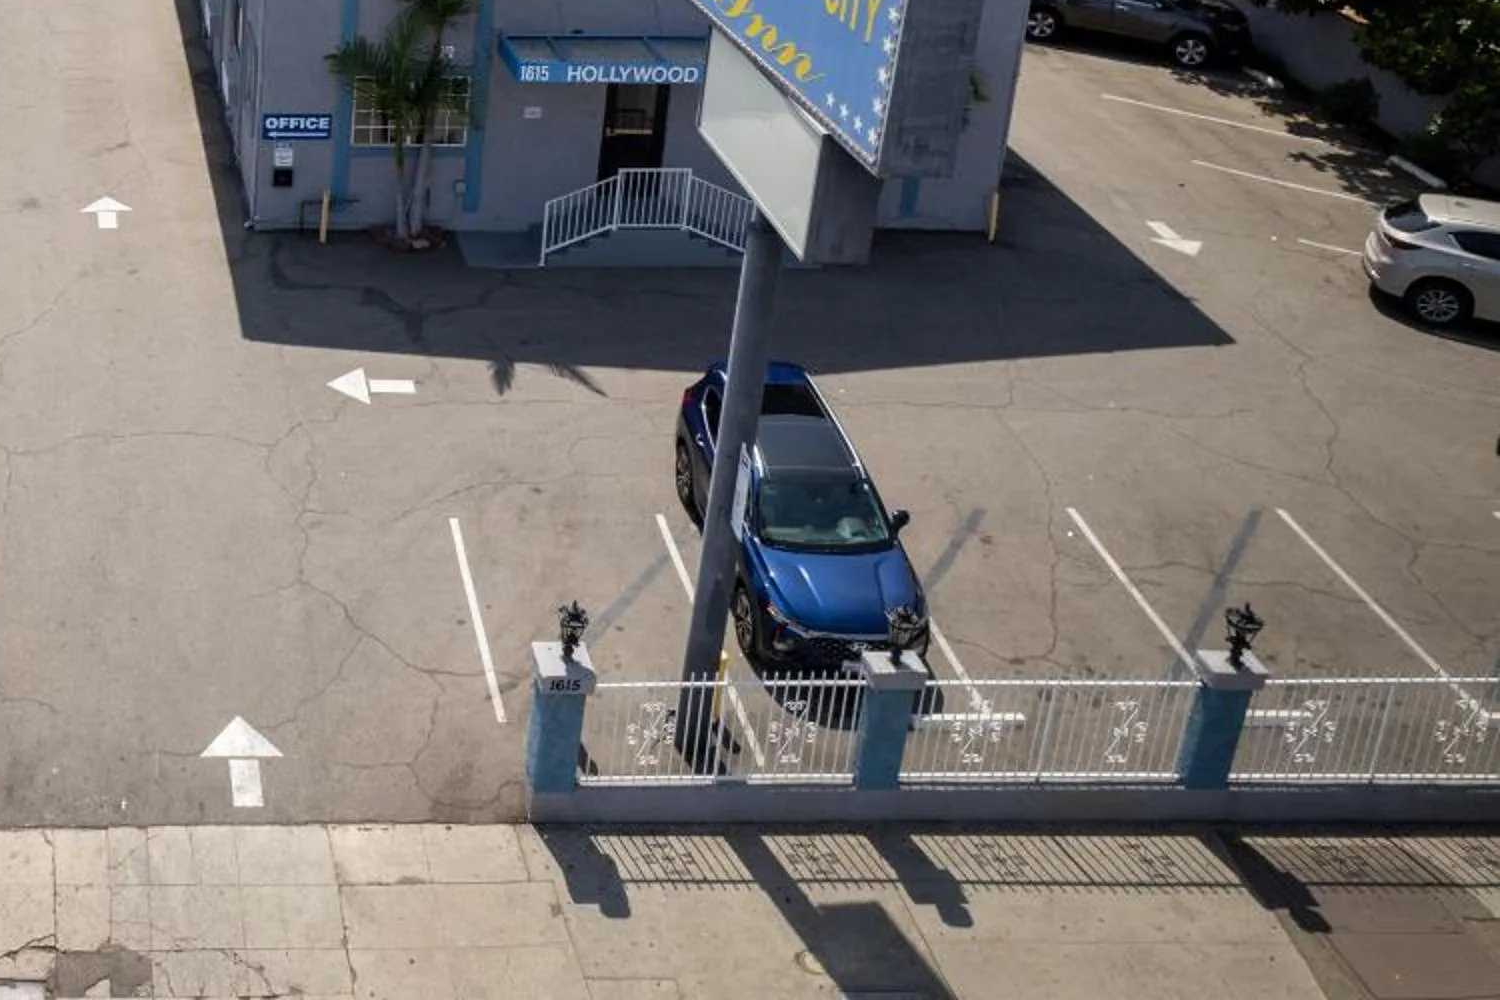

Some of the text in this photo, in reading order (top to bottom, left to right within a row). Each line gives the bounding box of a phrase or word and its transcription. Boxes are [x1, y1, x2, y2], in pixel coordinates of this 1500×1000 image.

[566, 65, 699, 83] HOLLYWOOD
[265, 117, 330, 129] OFFICE
[550, 679, 581, 691] 1615
